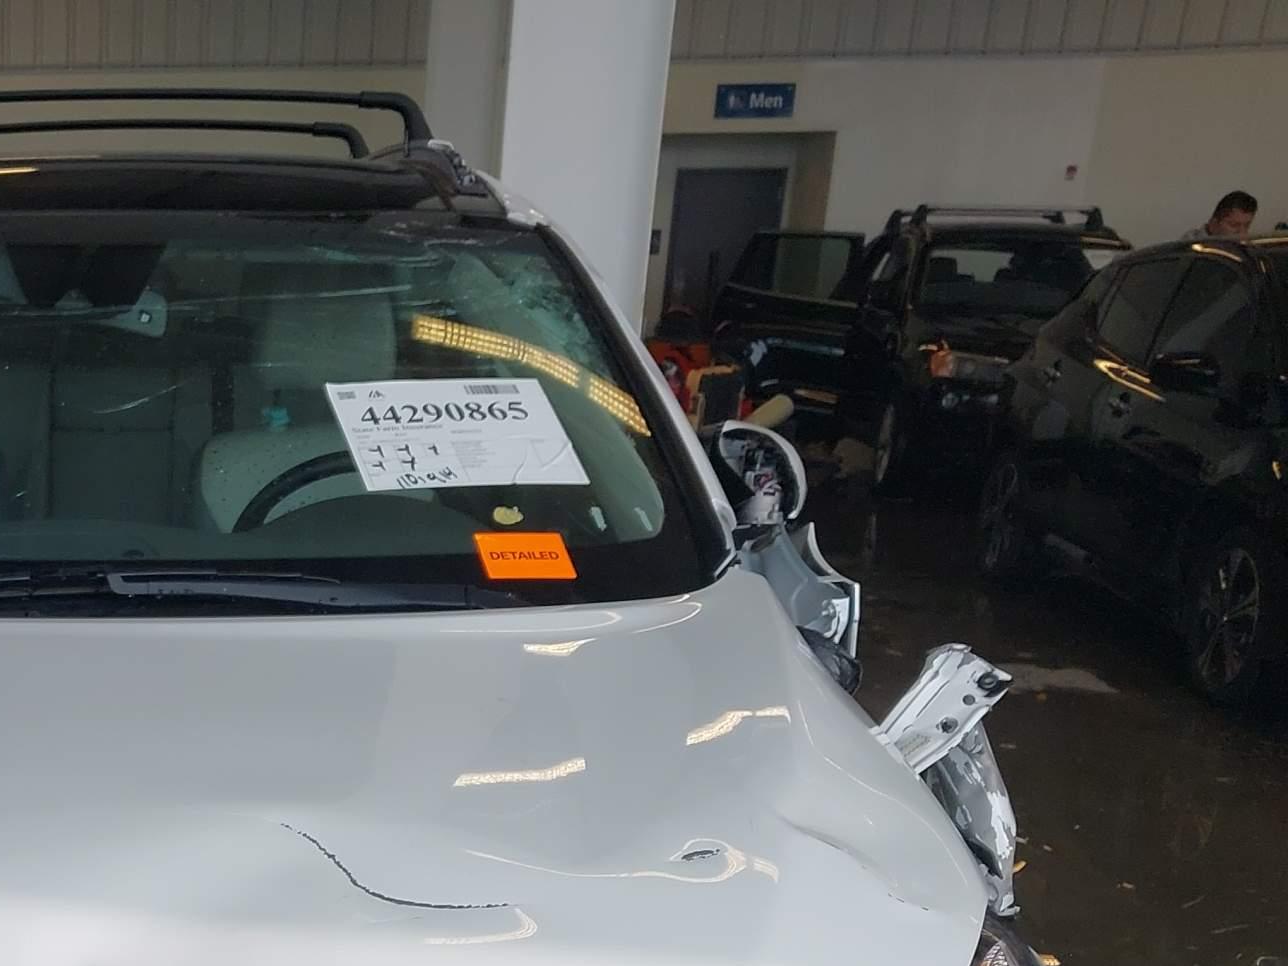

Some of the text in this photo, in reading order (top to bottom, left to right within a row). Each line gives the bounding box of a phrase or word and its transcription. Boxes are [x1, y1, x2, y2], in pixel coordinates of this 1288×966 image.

[749, 92, 783, 109] Men
[360, 401, 529, 426] 44290865
[489, 551, 560, 561] DETAILED
